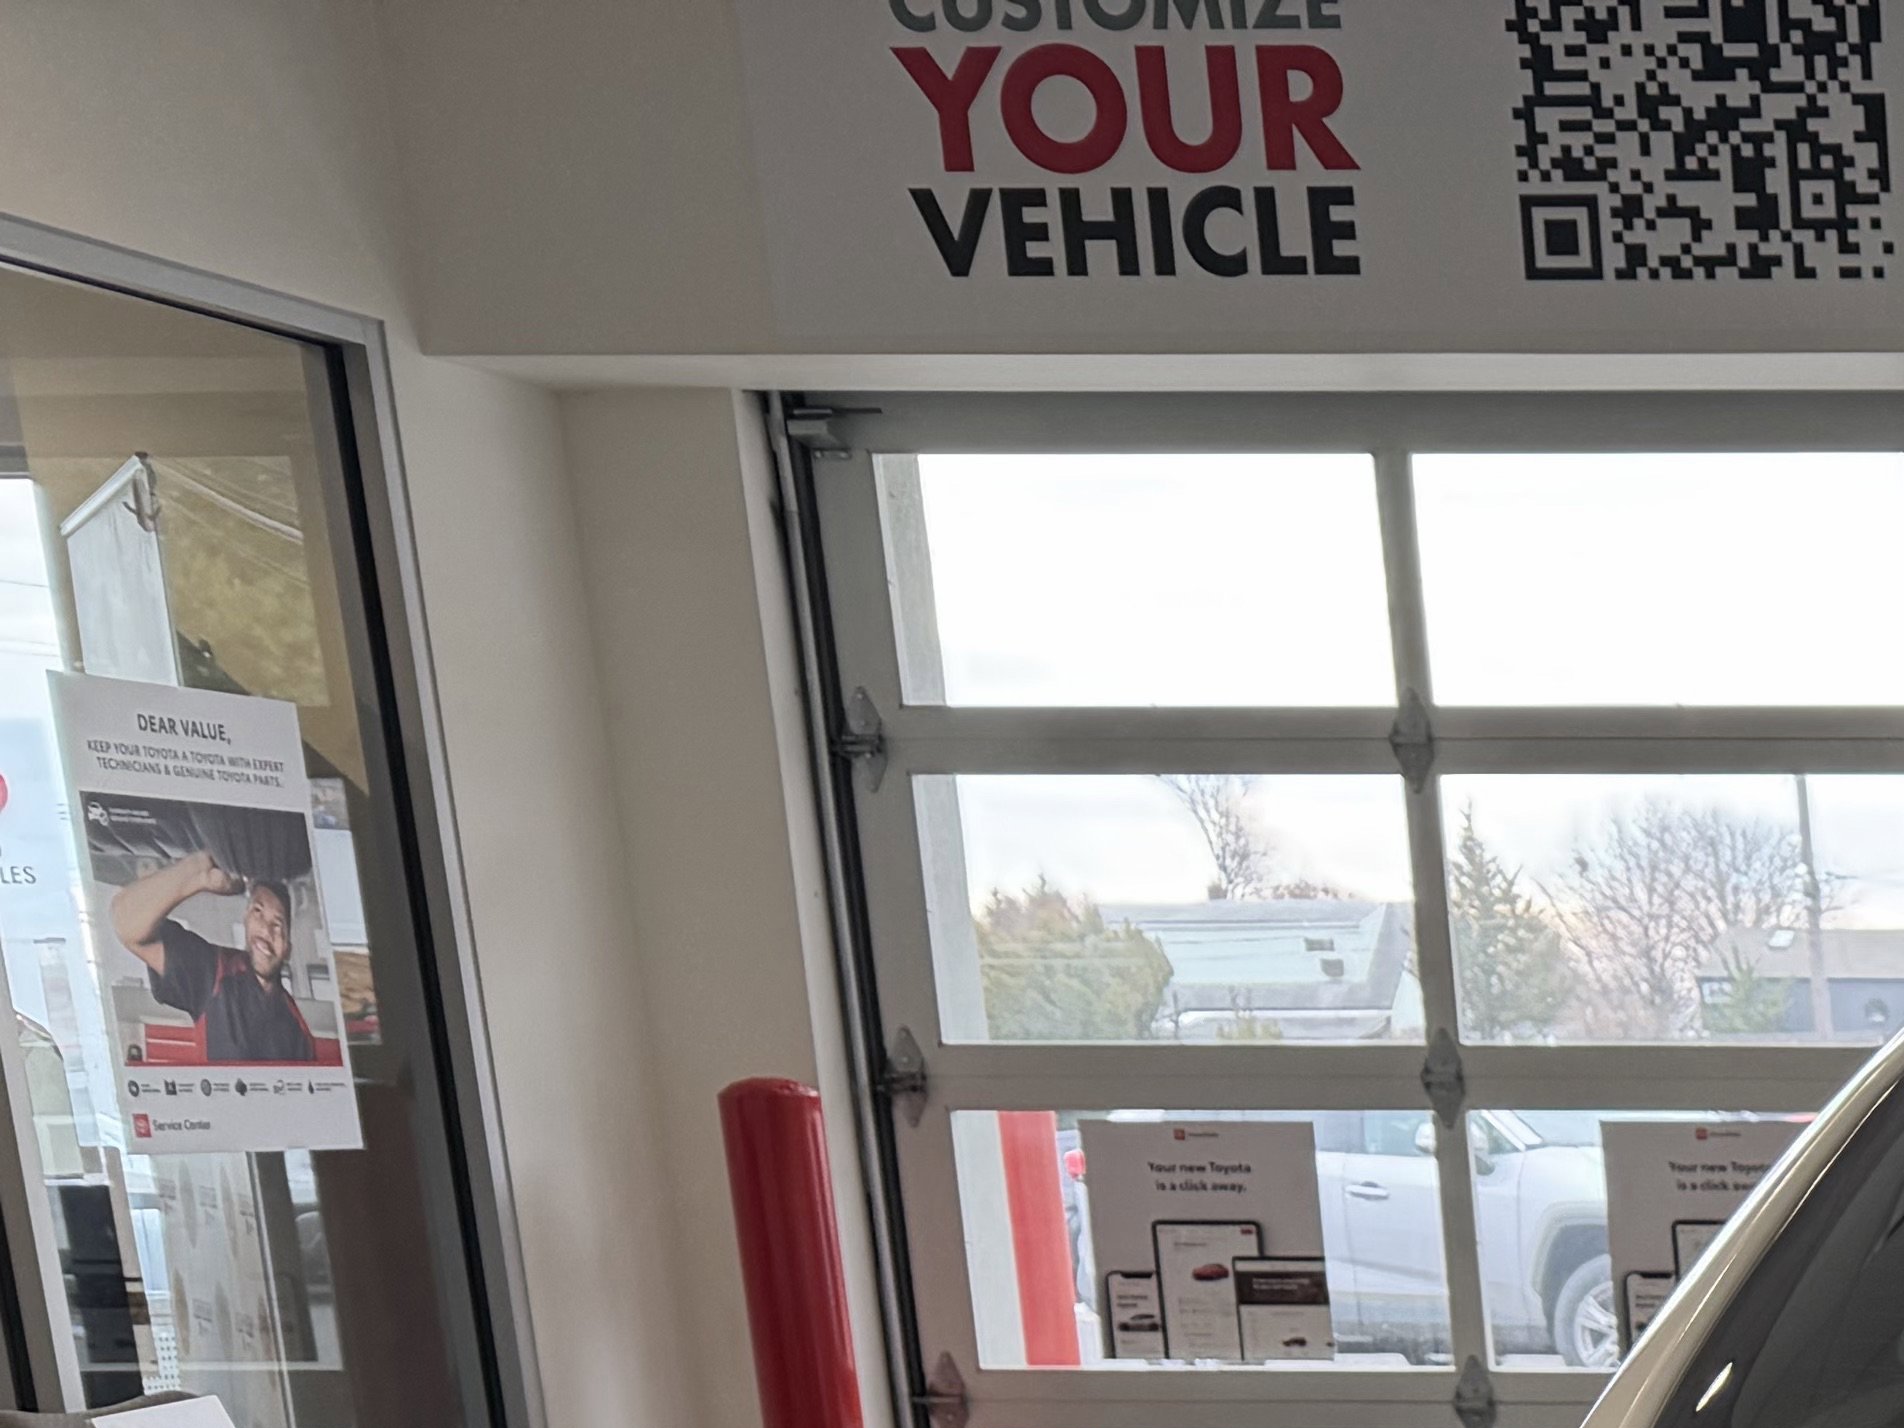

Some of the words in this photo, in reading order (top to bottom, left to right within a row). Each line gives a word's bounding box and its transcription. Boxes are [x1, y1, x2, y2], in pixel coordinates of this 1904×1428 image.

[889, 43, 1362, 175] YOUR
[907, 185, 1361, 277] VEHICLE
[137, 713, 178, 736] DEAR
[180, 719, 232, 745] VALUE,
[87, 740, 111, 754] KEEP
[114, 743, 141, 758] YOUR
[142, 746, 180, 761] TOYOTA
[189, 750, 226, 766] TOYOTA
[253, 758, 284, 773] EXPERT
[97, 757, 162, 775] TECHNICIANS
[173, 766, 215, 781] GENUINE
[216, 770, 251, 784] TOYOTA
